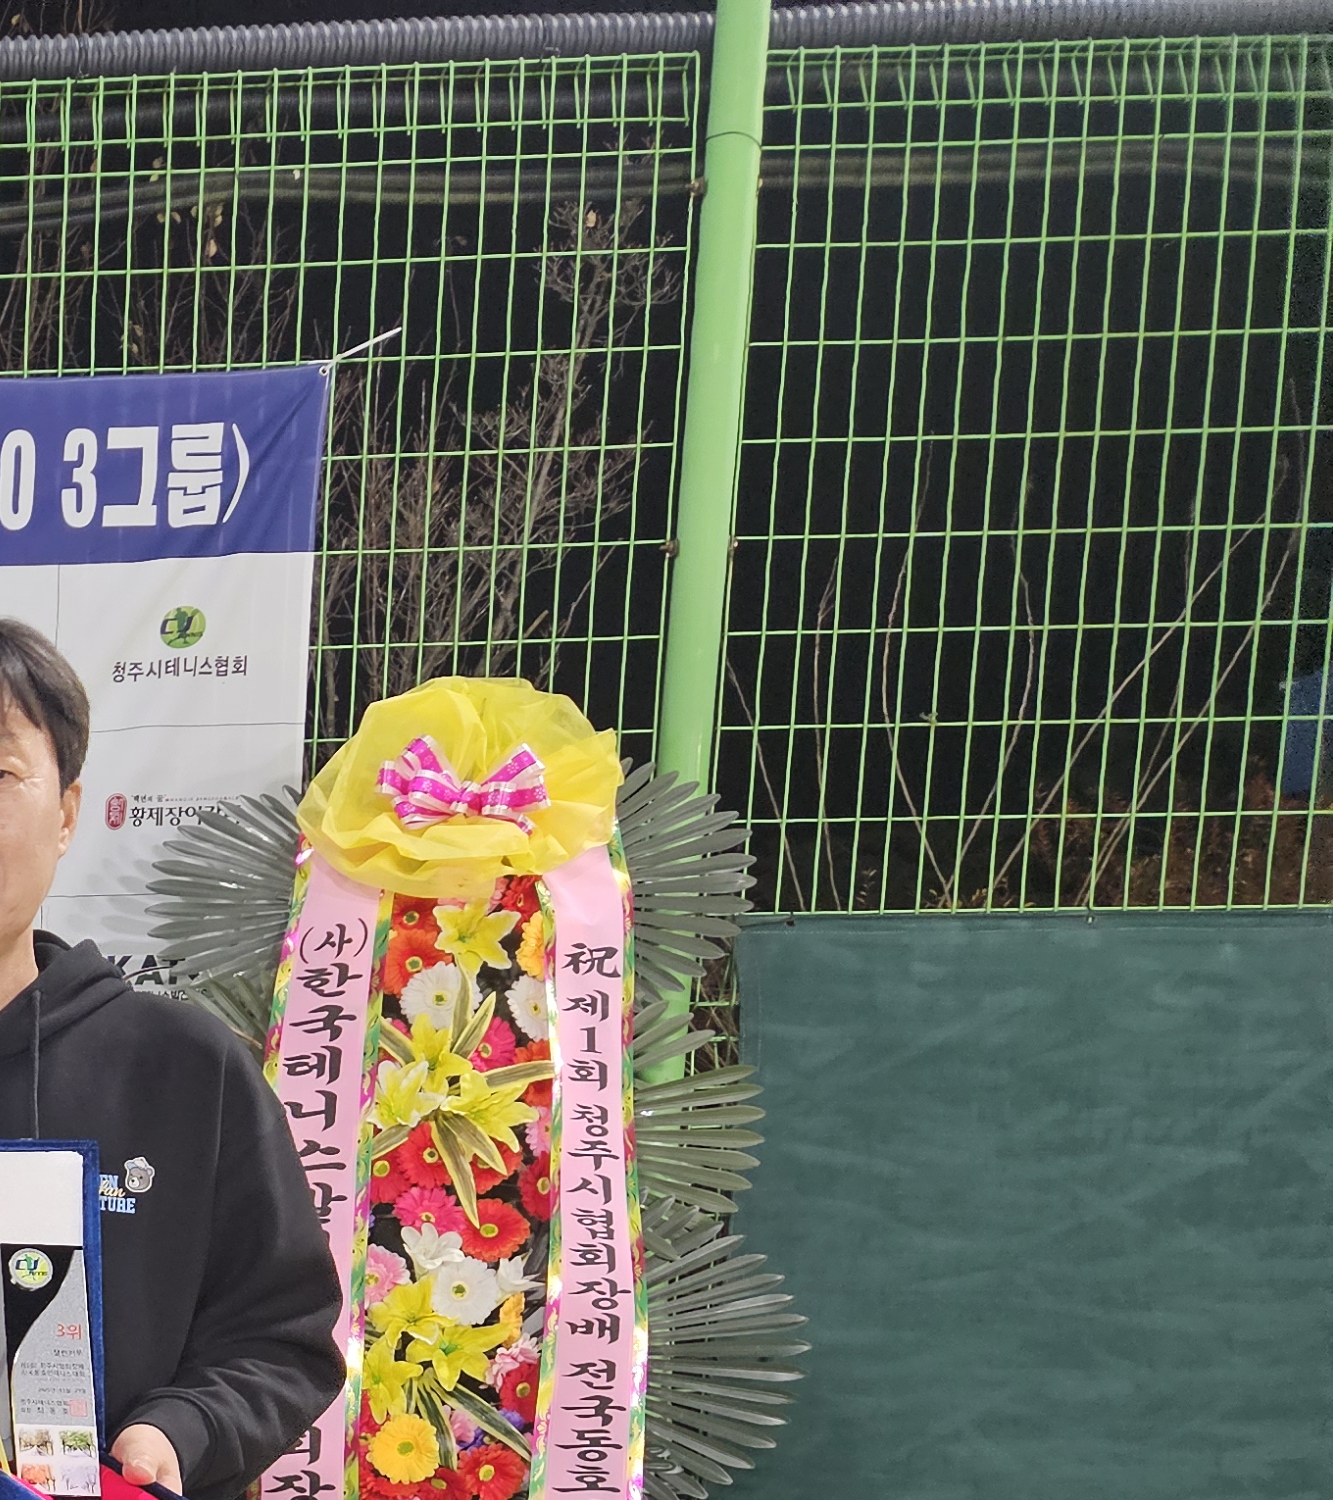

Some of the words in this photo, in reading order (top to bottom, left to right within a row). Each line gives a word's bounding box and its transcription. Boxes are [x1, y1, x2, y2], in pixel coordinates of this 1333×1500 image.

[61, 422, 253, 530] 3그룹)
[112, 655, 249, 684] 청주시테니스협회
[561, 942, 622, 979] 祝
[566, 990, 611, 1092] 제1회
[565, 1104, 632, 1345] 청주시협회장배
[56, 1323, 82, 1340] 3위
